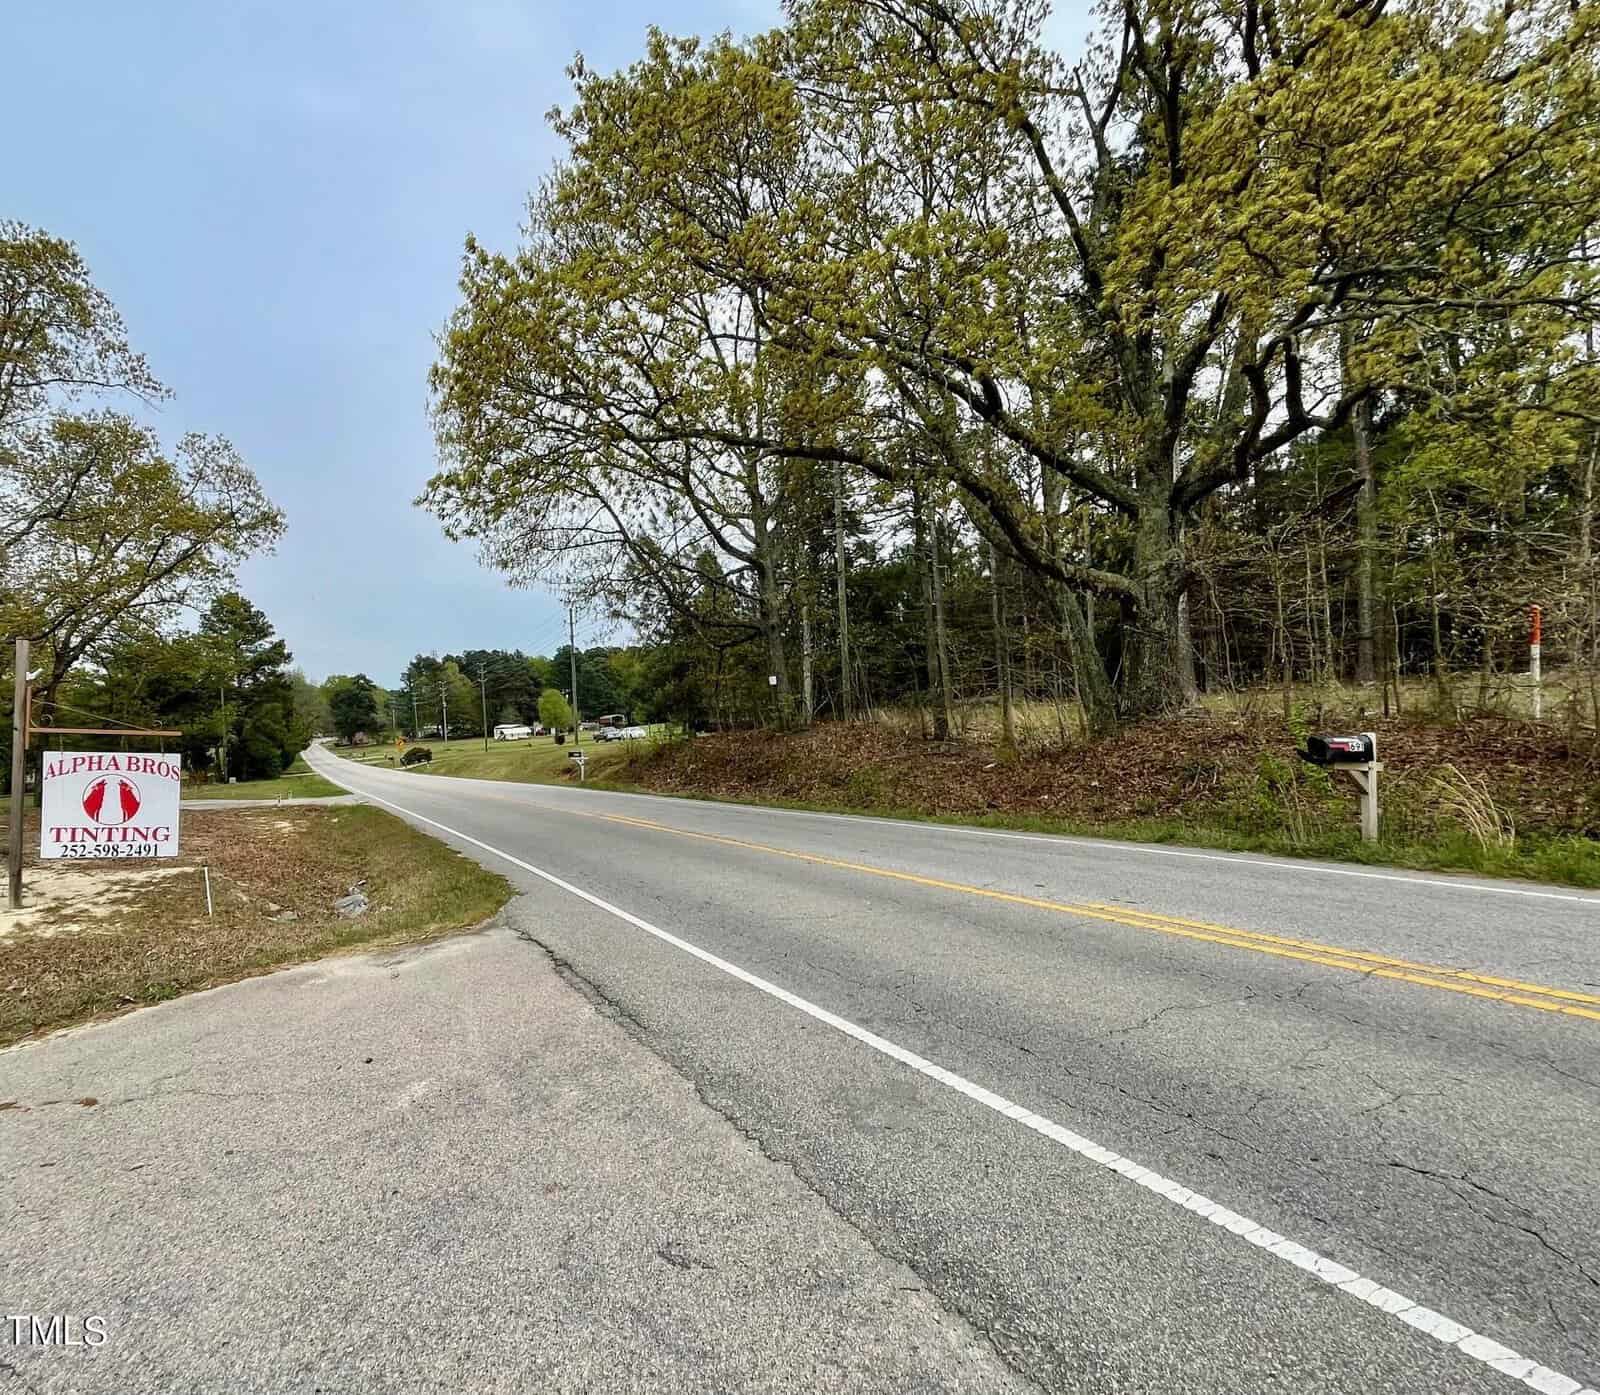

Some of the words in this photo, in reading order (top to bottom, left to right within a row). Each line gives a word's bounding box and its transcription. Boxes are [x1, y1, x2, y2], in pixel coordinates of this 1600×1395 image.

[44, 754, 120, 780] ALPHA
[127, 756, 180, 782] BROS
[50, 827, 171, 843] TINTING
[60, 844, 158, 857] 252-598-2491
